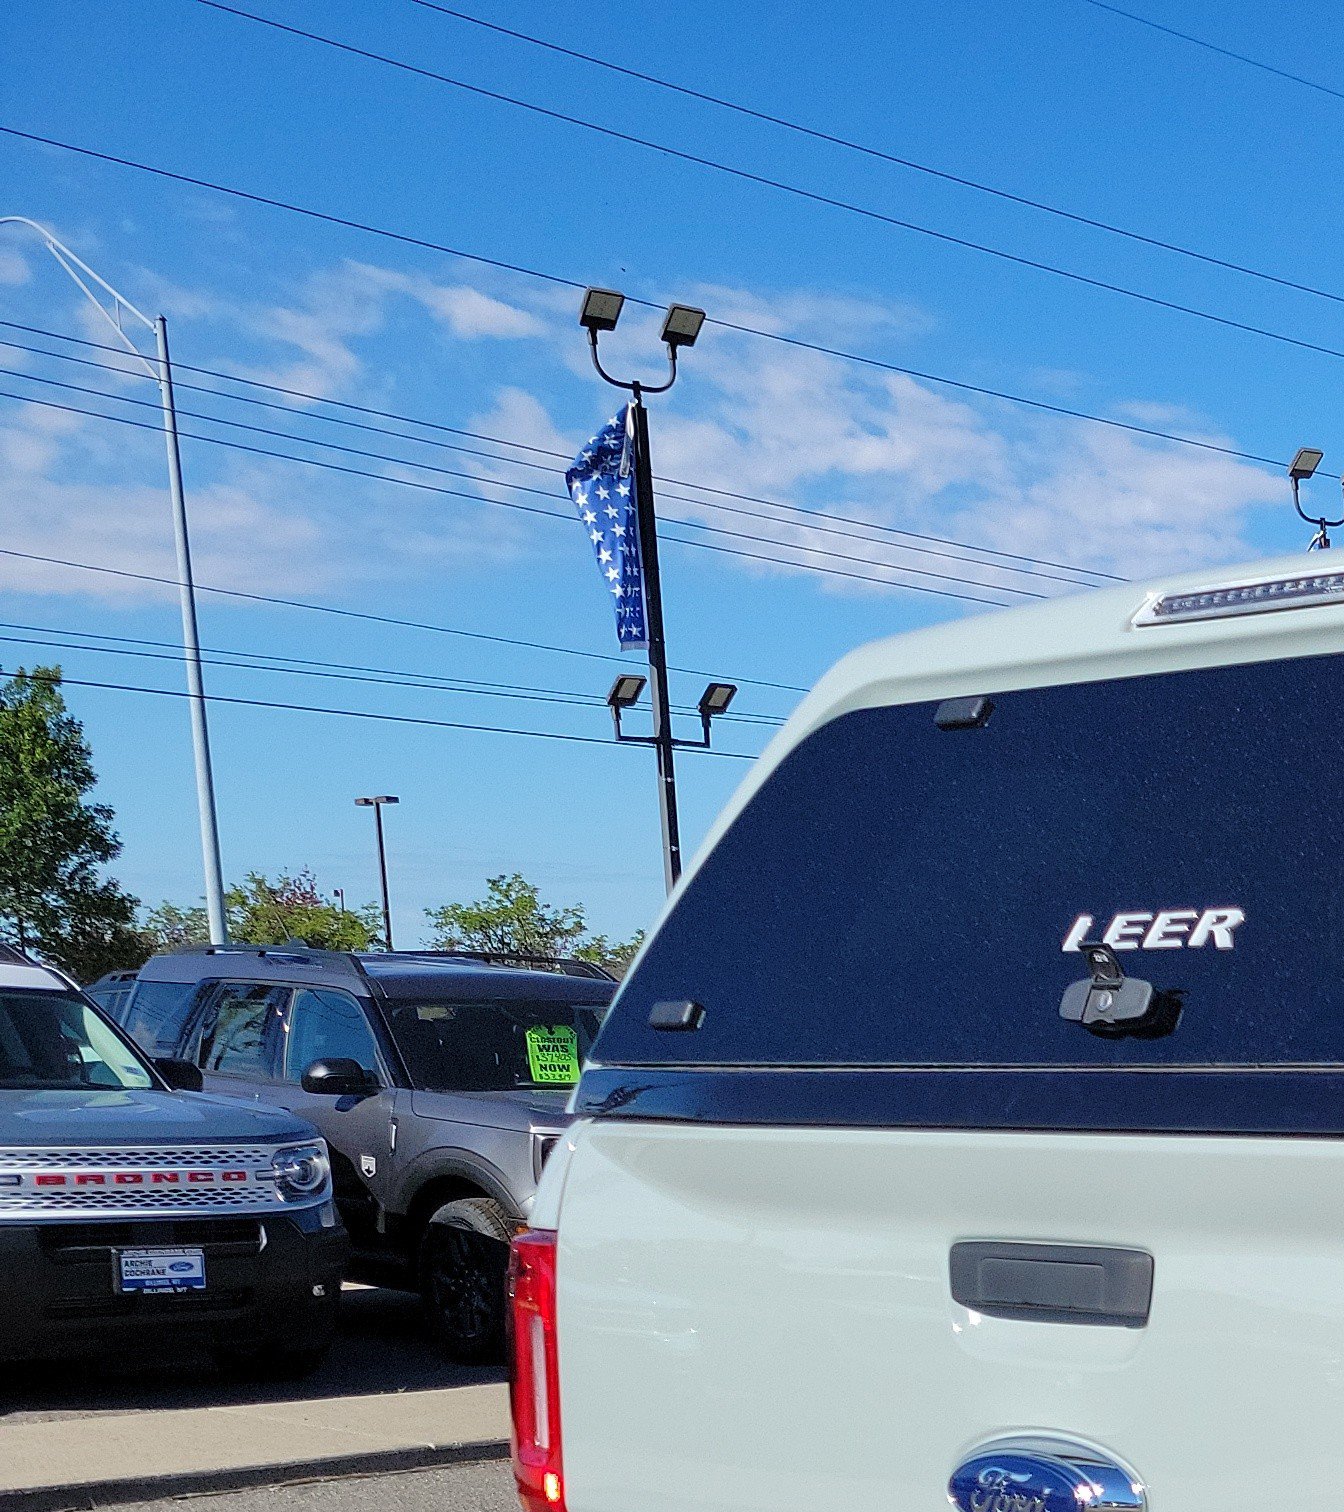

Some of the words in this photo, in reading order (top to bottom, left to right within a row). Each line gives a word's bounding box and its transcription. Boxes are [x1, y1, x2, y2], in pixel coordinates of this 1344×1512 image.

[1061, 906, 1246, 952] LEER
[537, 1044, 569, 1053] WAS
[539, 1063, 571, 1073] NOW
[35, 1171, 246, 1187] BRONCO
